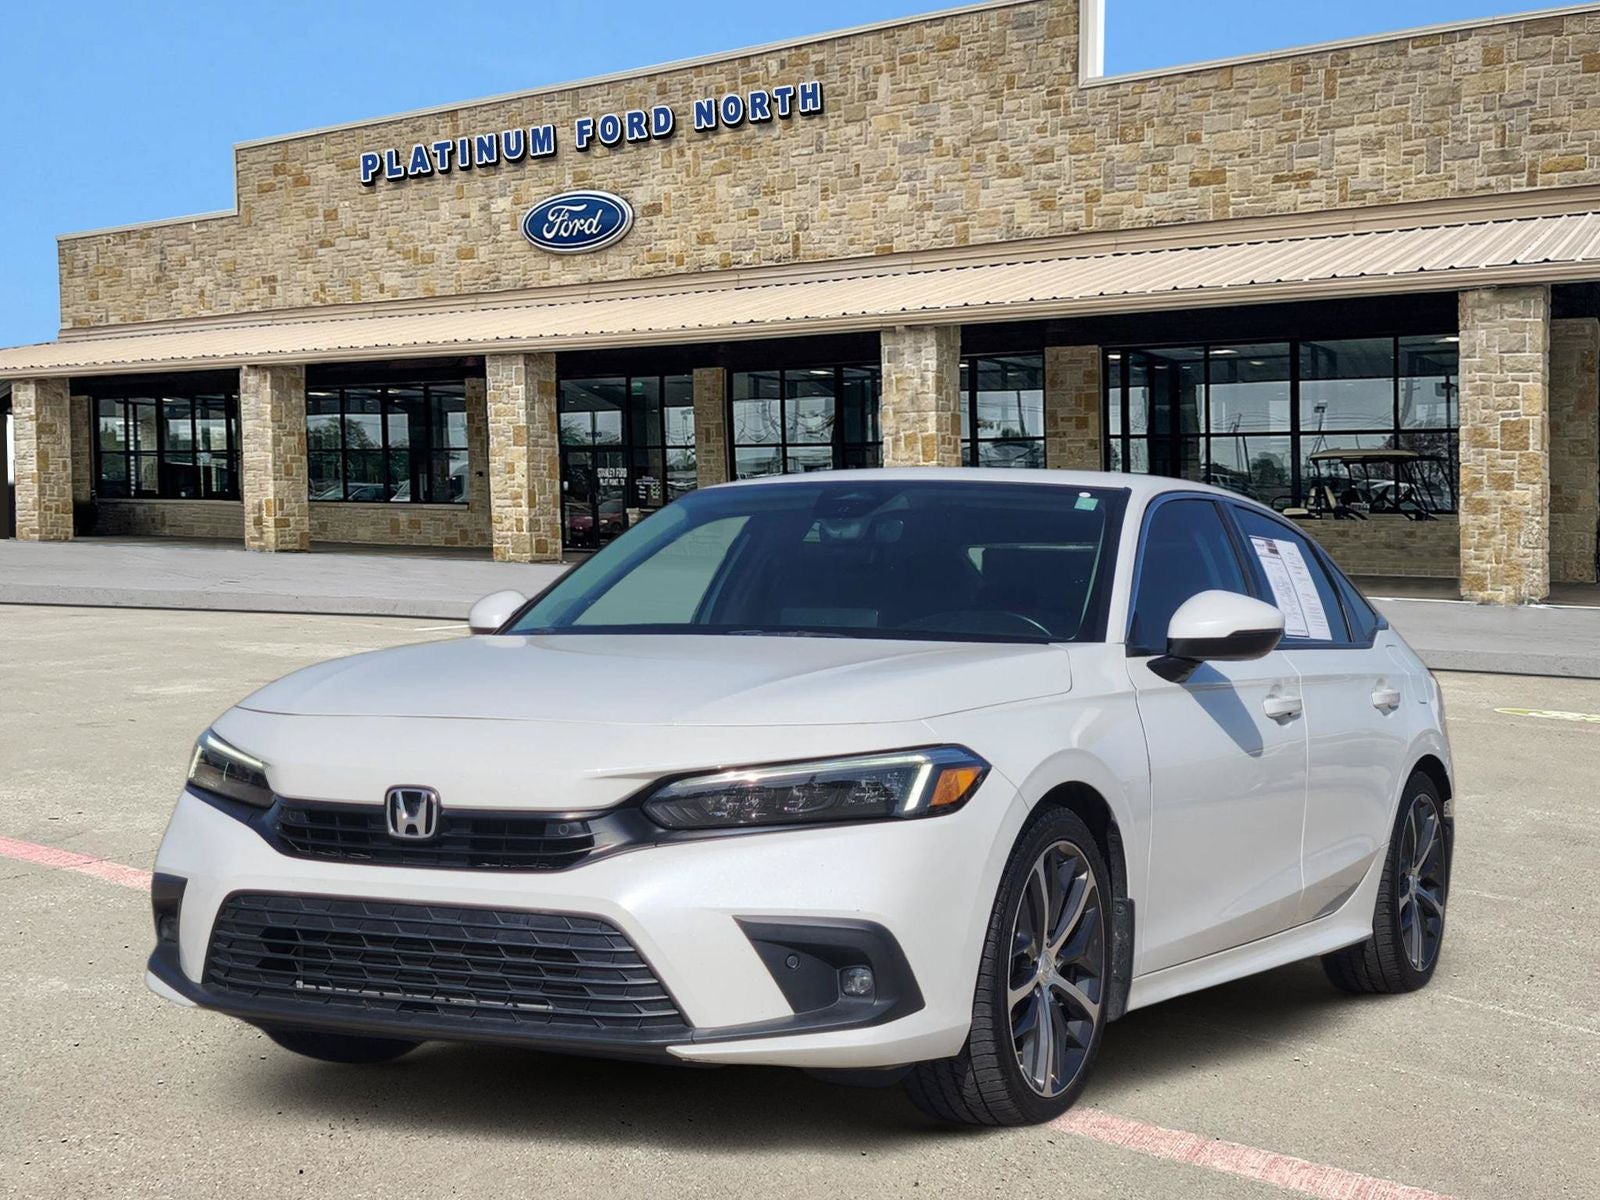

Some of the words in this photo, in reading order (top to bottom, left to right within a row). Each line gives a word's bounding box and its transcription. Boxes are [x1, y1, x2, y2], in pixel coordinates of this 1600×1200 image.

[360, 124, 557, 186] PLATINUM
[575, 105, 675, 150] FORD
[694, 81, 822, 133] NORTH
[543, 204, 603, 239] Ford
[616, 468, 627, 478] FORD
